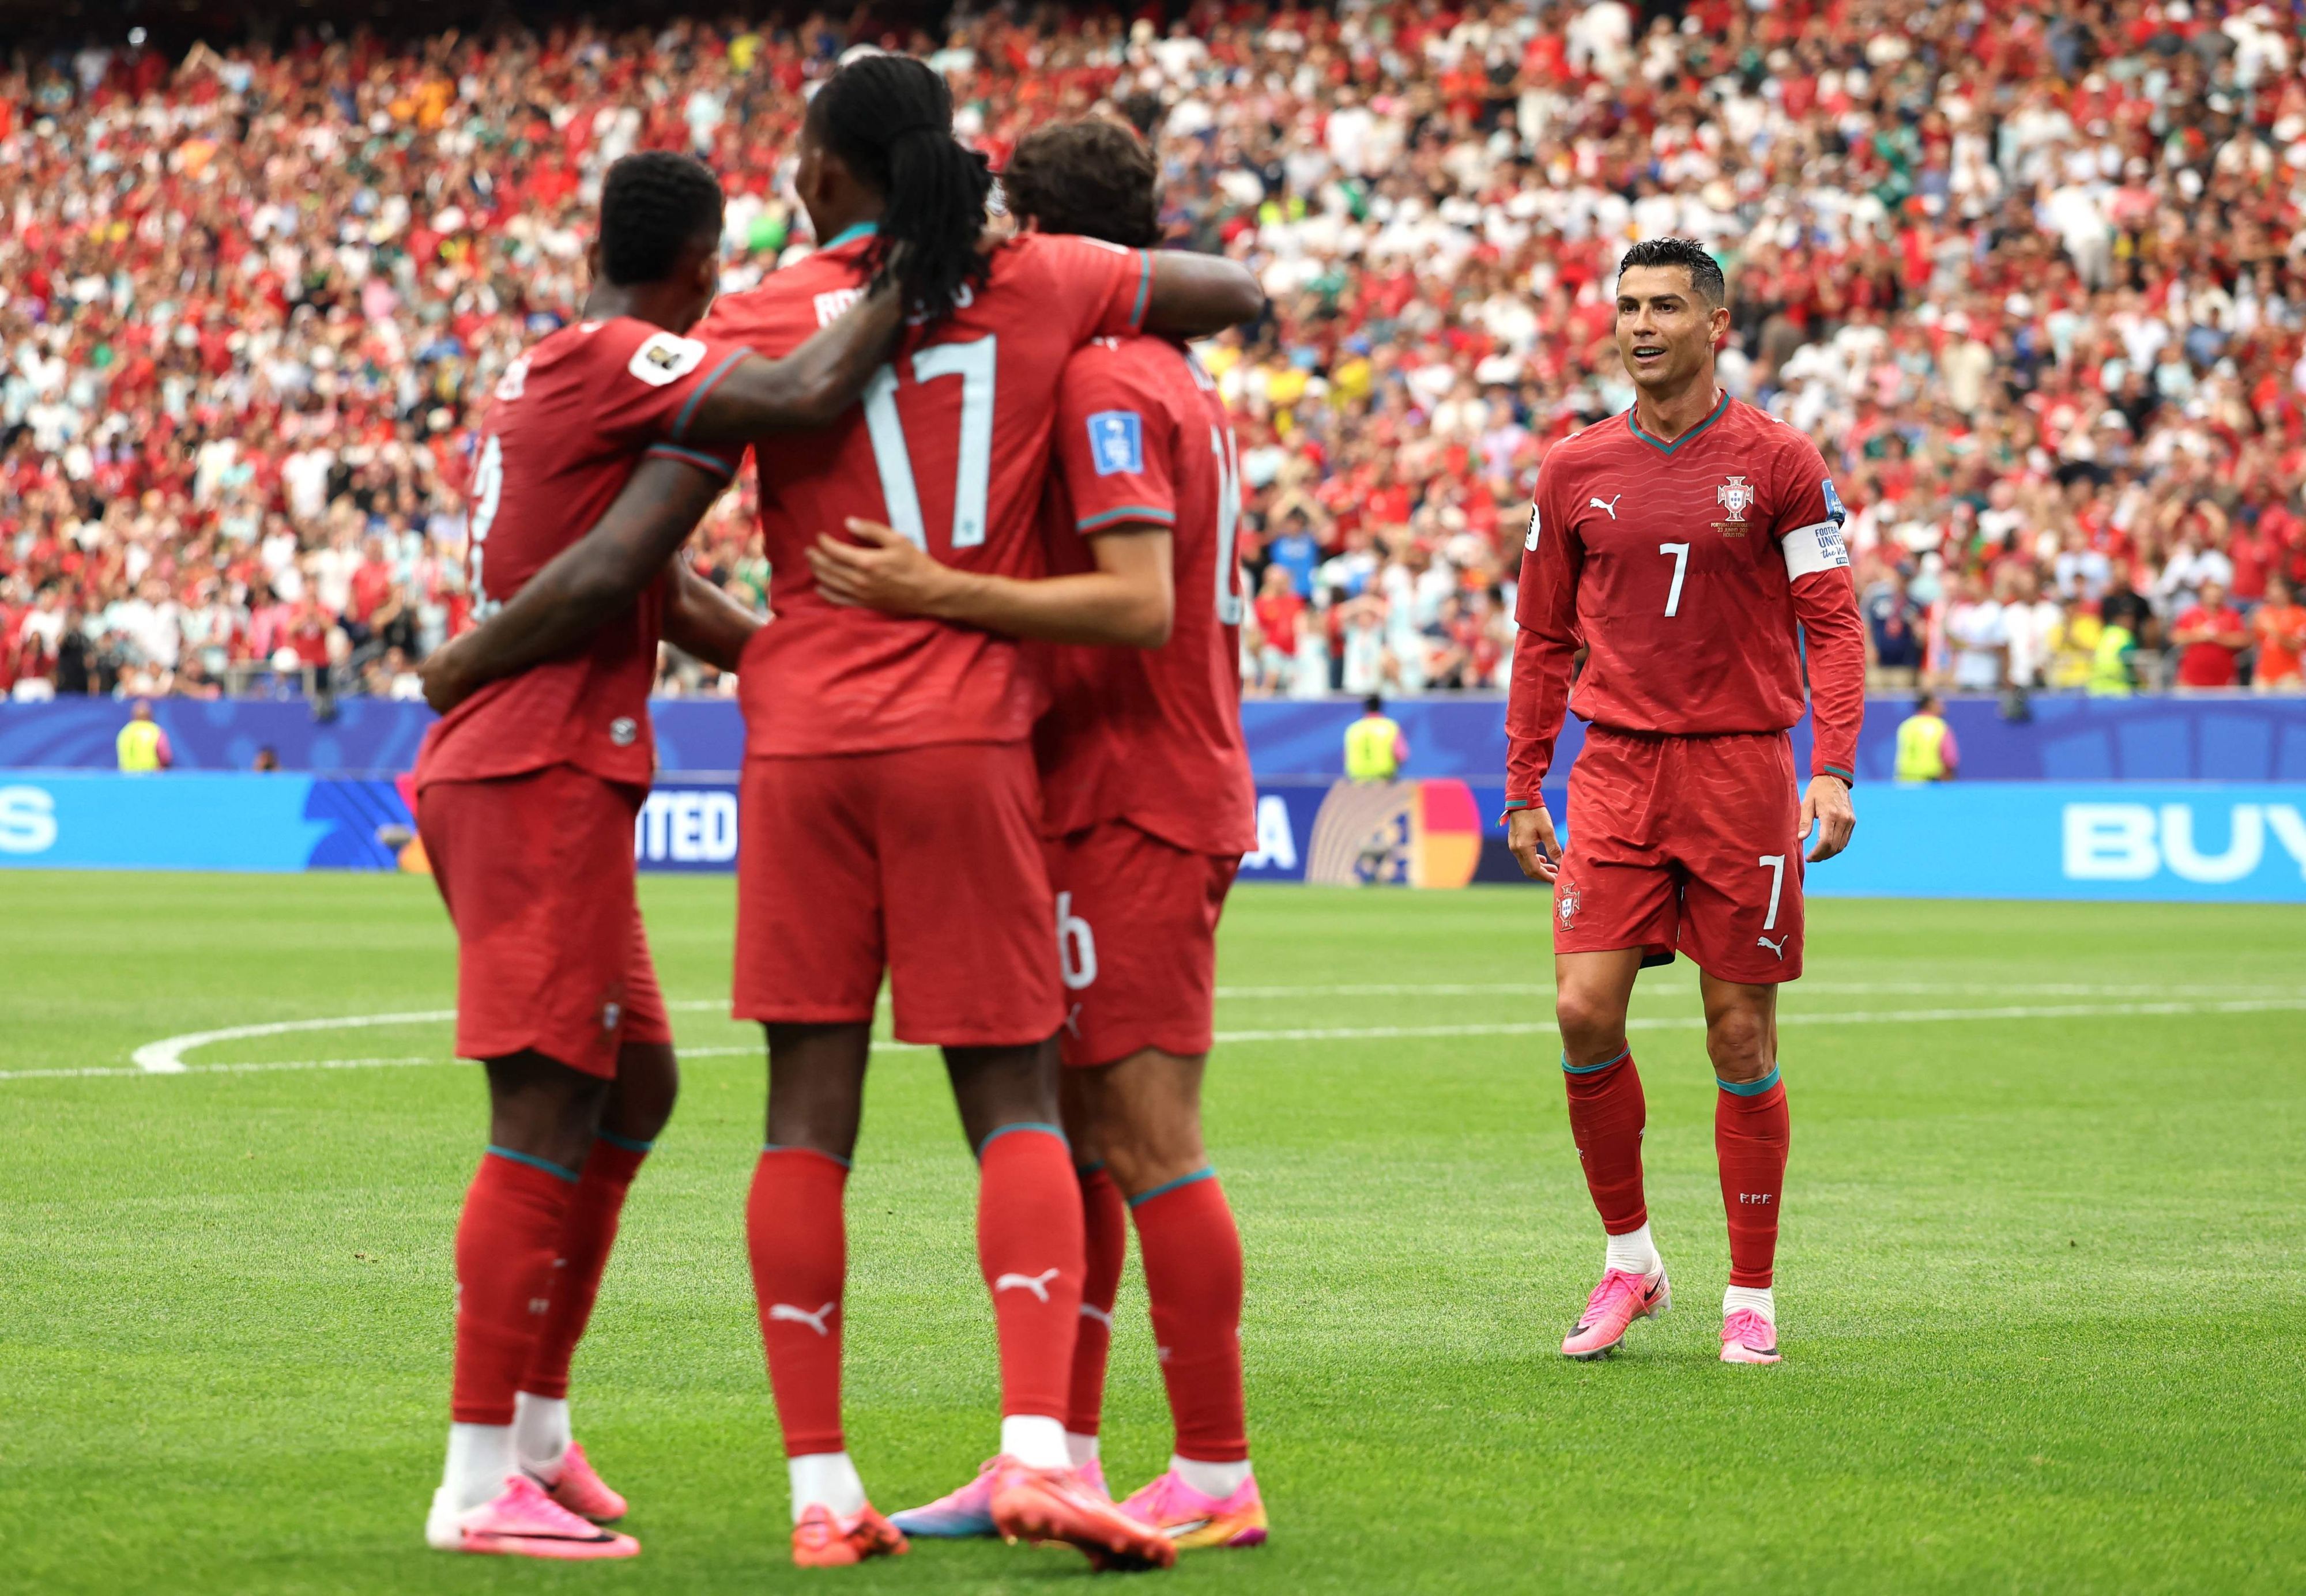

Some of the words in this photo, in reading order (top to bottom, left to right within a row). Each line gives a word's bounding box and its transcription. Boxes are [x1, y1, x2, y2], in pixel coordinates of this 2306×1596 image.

[863, 333, 996, 552] 17
[1660, 542, 1690, 617] 7
[1820, 548, 1836, 559] the
[1759, 854, 1785, 930] 7
